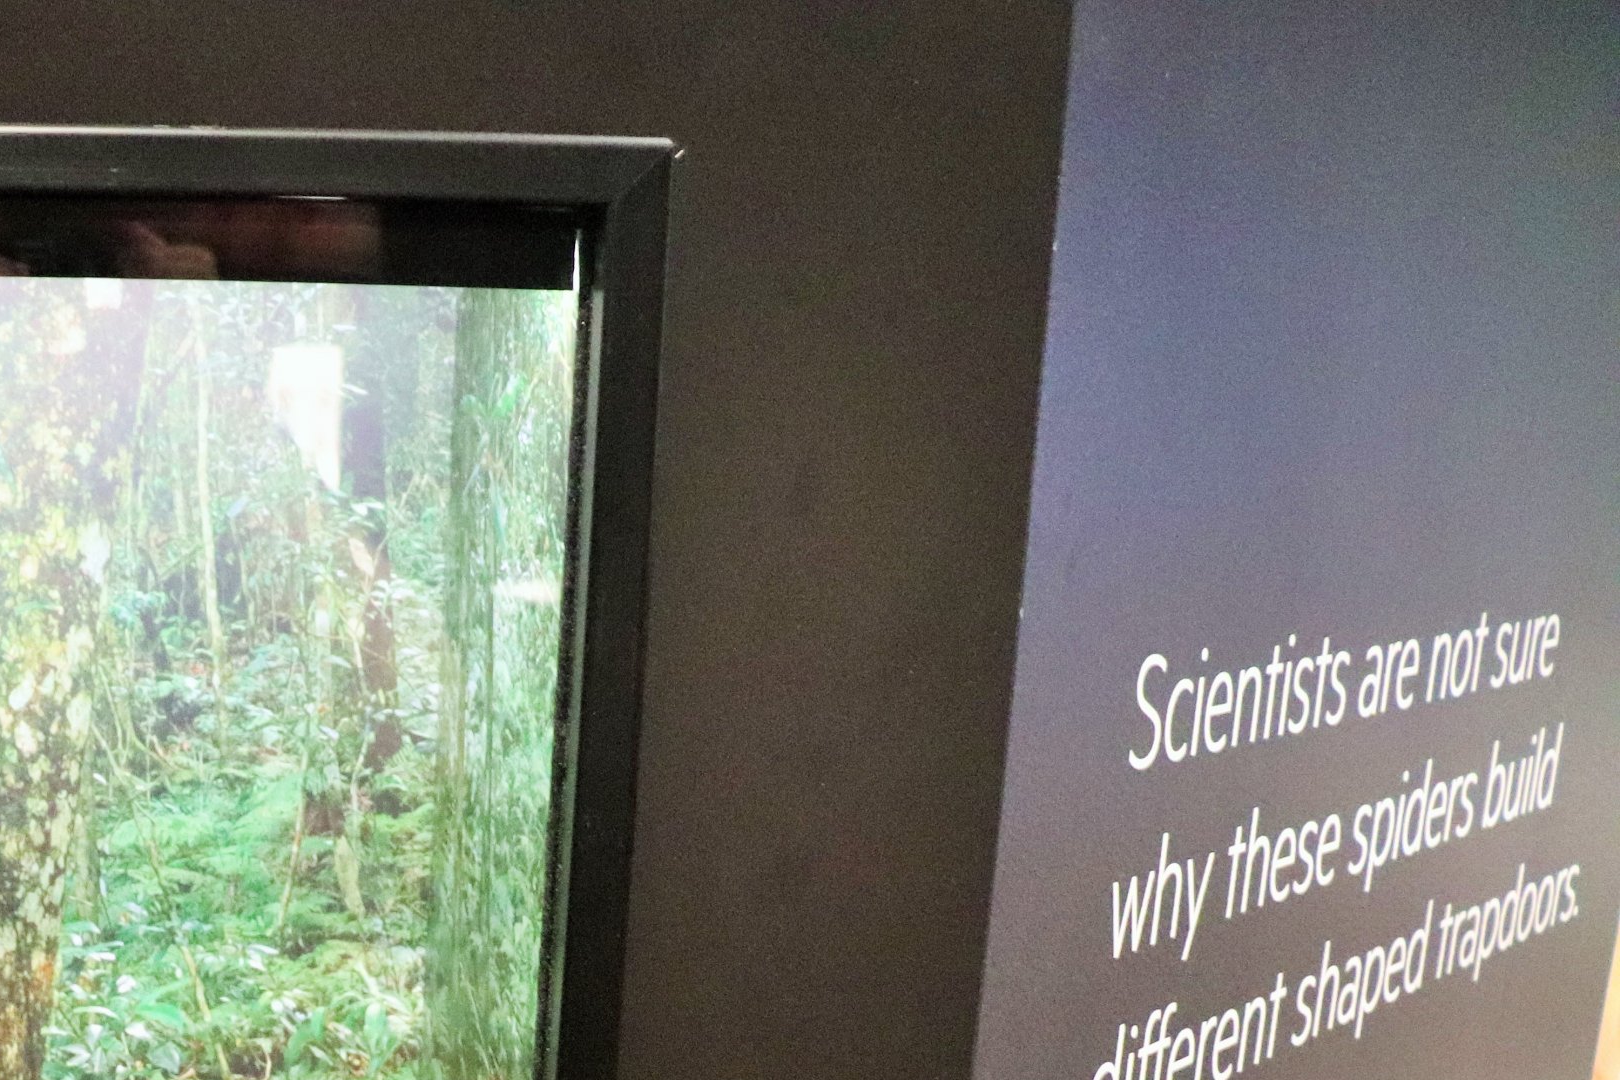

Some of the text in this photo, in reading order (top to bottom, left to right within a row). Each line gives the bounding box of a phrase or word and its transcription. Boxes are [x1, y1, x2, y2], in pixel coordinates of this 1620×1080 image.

[1128, 611, 1561, 771] Scientists are not sure
[1111, 721, 1565, 962] why these spiders build
[1290, 900, 1435, 1048] shaped
[1434, 862, 1581, 982] trapdoors.
